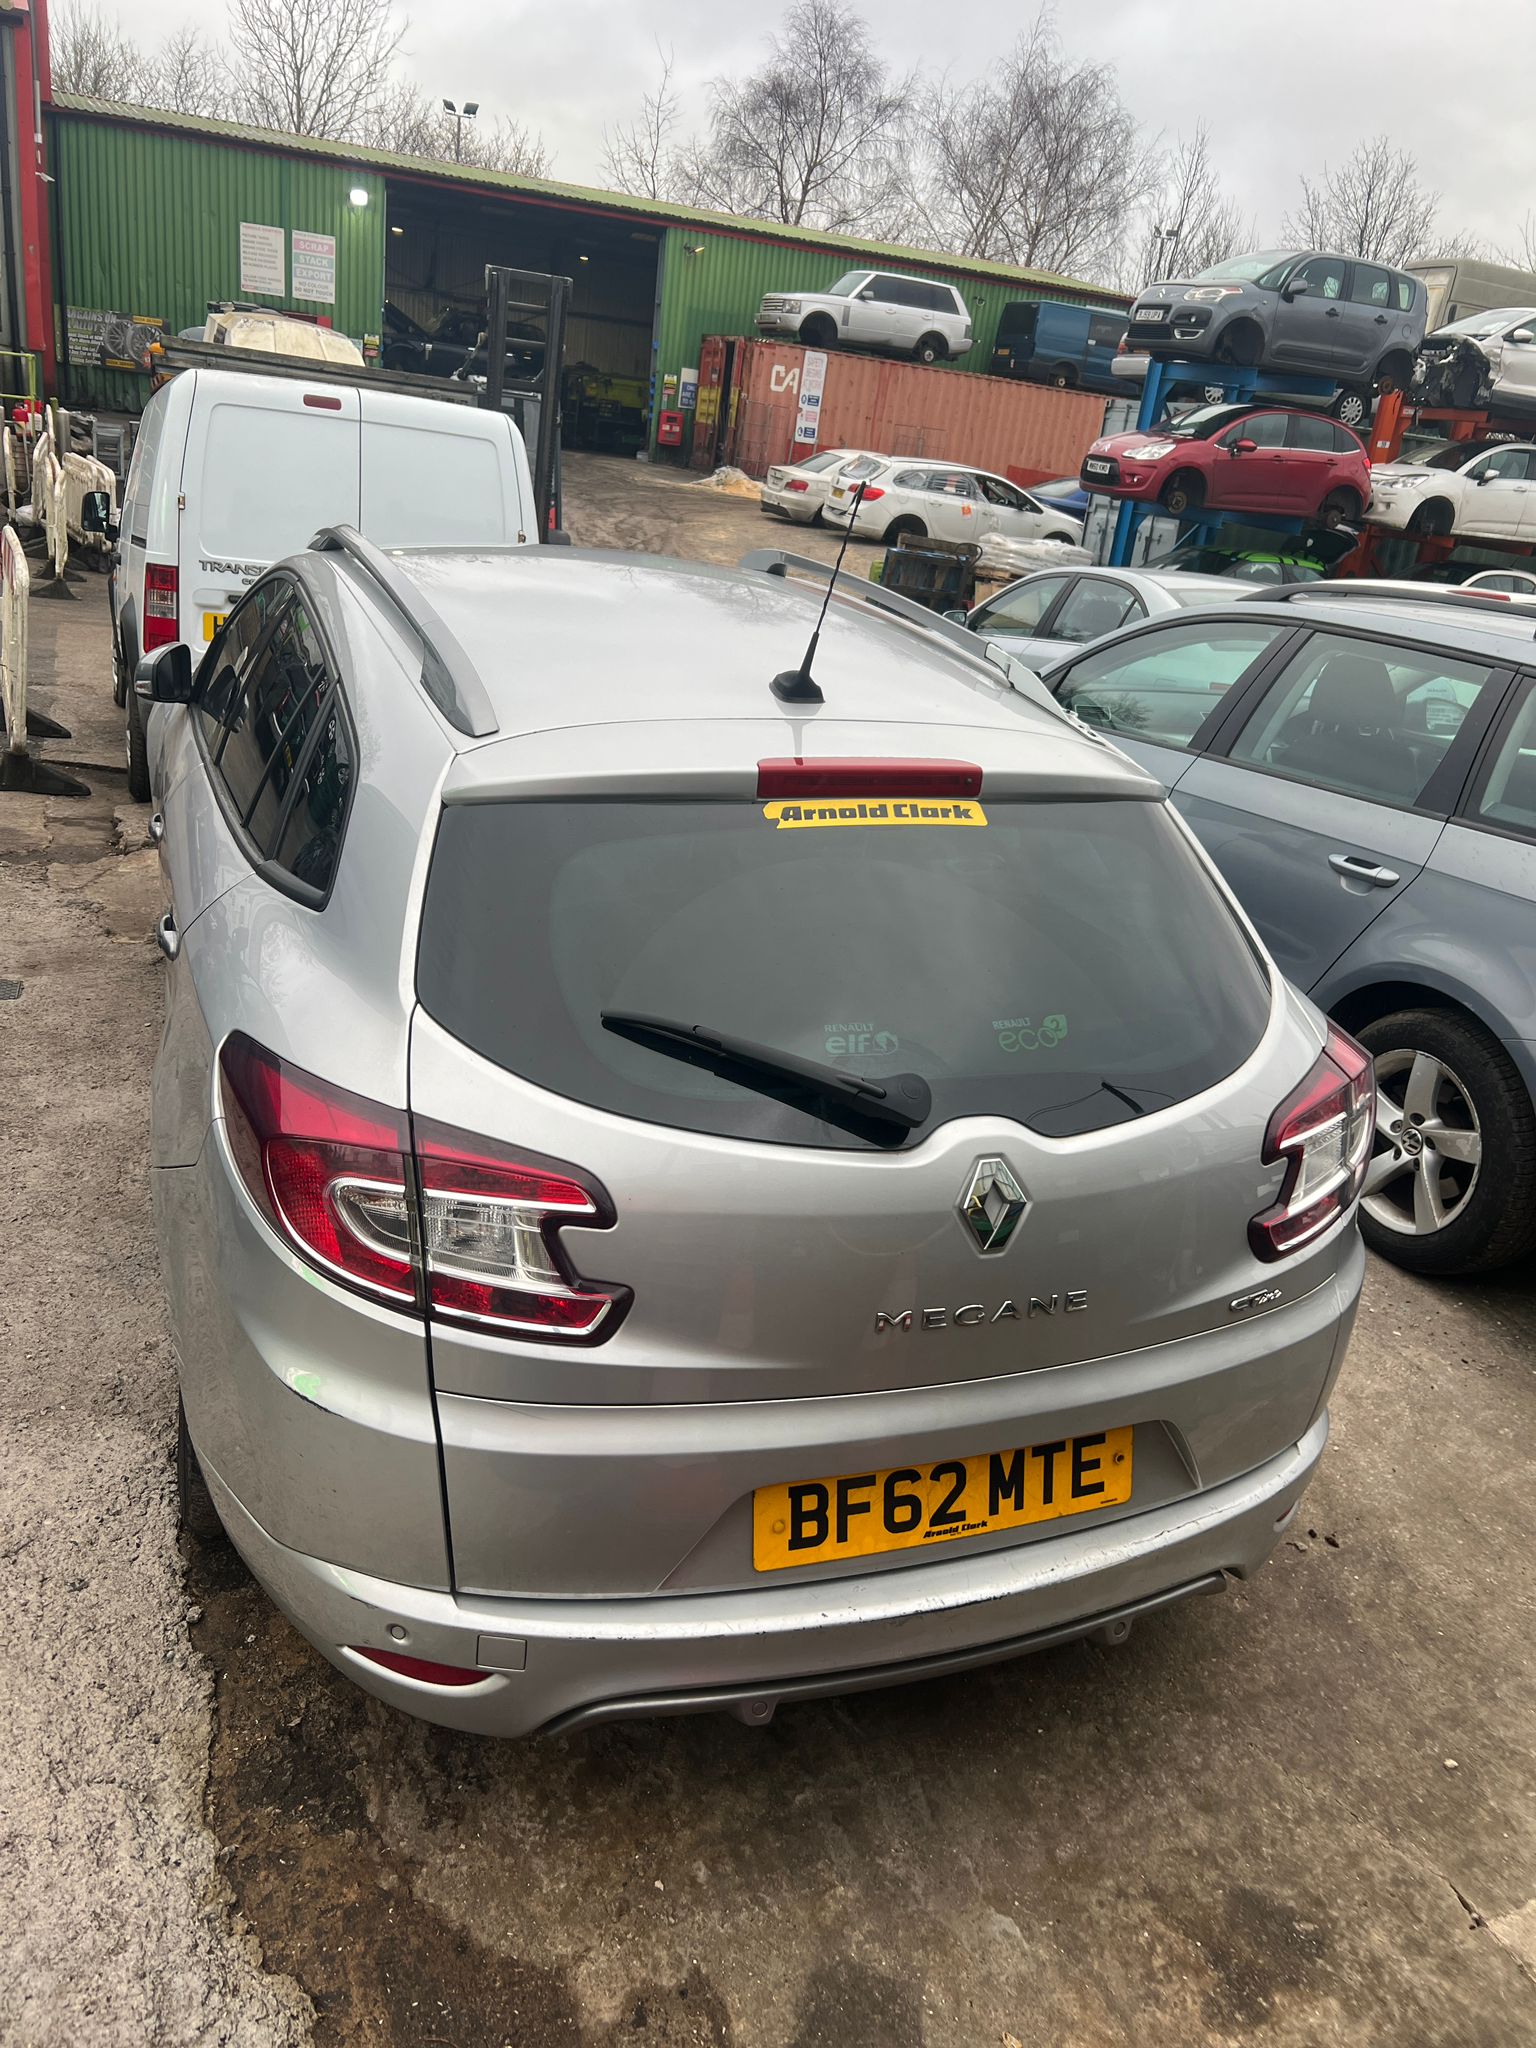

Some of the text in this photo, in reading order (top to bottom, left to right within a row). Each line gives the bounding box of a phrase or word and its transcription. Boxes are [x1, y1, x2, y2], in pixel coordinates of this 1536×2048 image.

[299, 240, 329, 253] SCRAP
[299, 254, 328, 267] STACK
[296, 267, 332, 281] EXPORT
[104, 313, 117, 324] ON
[780, 803, 974, 822] Arnold Clark
[824, 1022, 874, 1033] RENAULT
[992, 1017, 1031, 1030] RENAULT
[825, 1033, 871, 1054] elf
[874, 1288, 1088, 1335] MEGANE
[787, 1432, 1107, 1552] BF62 MTE
[923, 1520, 988, 1539] Arnold Clark
